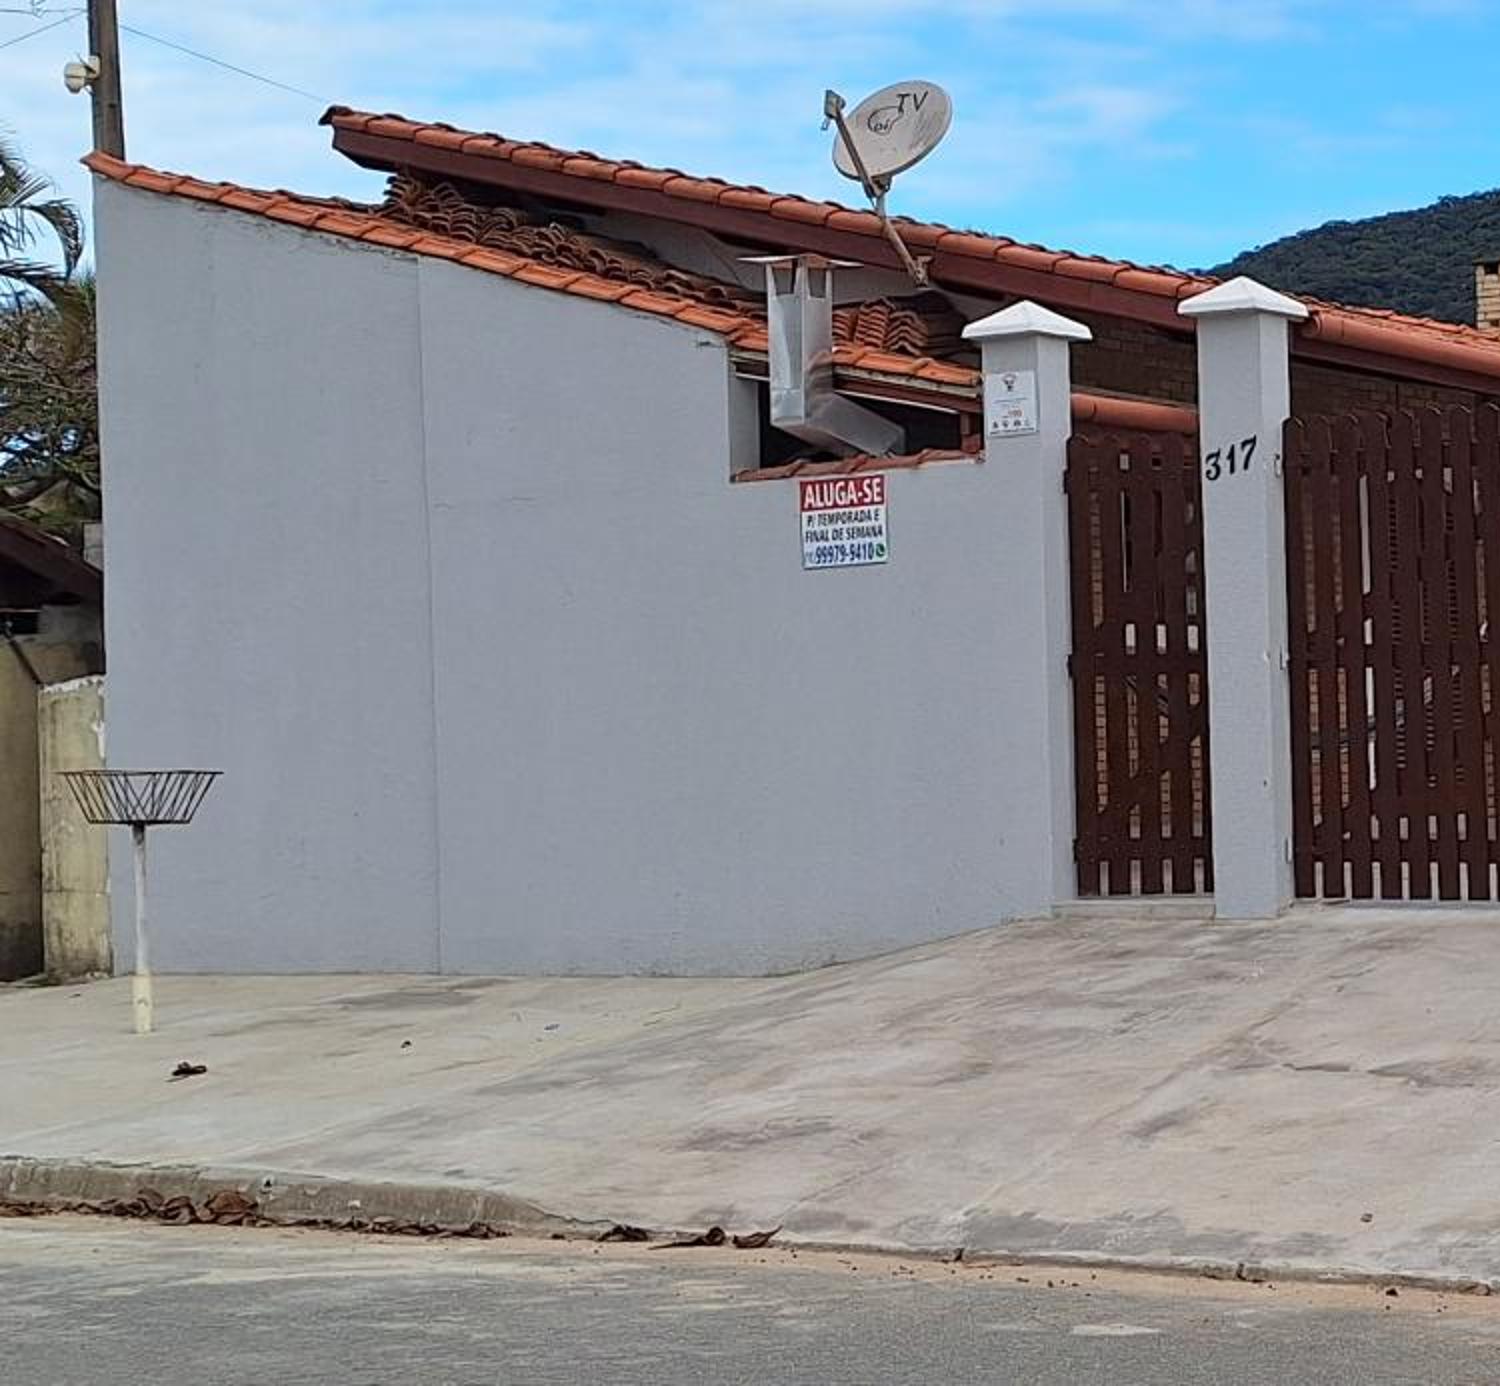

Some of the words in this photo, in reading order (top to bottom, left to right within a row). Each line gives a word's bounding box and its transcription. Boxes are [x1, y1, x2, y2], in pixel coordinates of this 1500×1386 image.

[896, 91, 929, 113] TV
[1205, 434, 1257, 481] 317
[803, 478, 882, 509] ALUGA-SE
[818, 509, 872, 527] TEMPORADA
[874, 508, 880, 522] E
[806, 529, 829, 543] FINAL
[832, 527, 844, 541] DE
[846, 524, 883, 540] SEMANA
